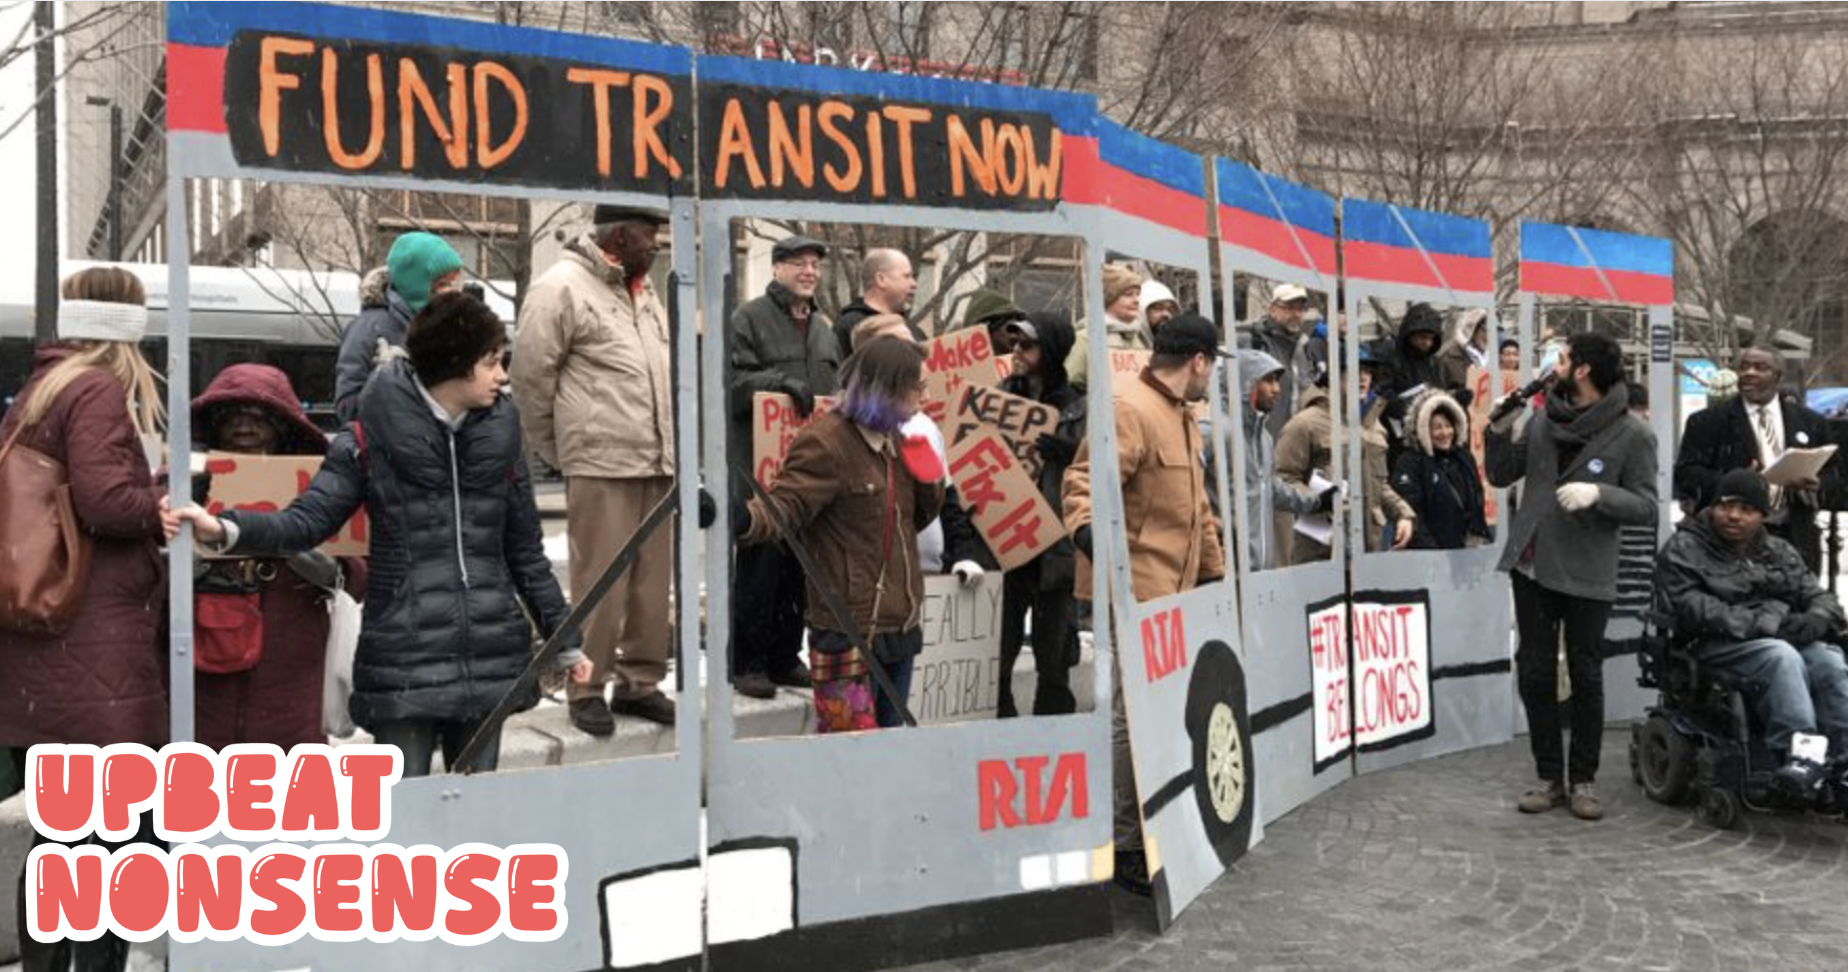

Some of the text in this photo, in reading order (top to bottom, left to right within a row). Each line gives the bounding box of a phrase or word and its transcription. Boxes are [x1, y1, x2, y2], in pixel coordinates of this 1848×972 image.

[259, 36, 529, 170] FUND
[947, 113, 1063, 199] NOW
[958, 385, 1048, 437] KEEP
[922, 586, 1000, 646] EALLY
[1140, 607, 1188, 684] RTA
[1311, 607, 1413, 673] #TRANSIT
[911, 656, 1000, 720] RRIBLE
[977, 752, 1089, 832] RTA
